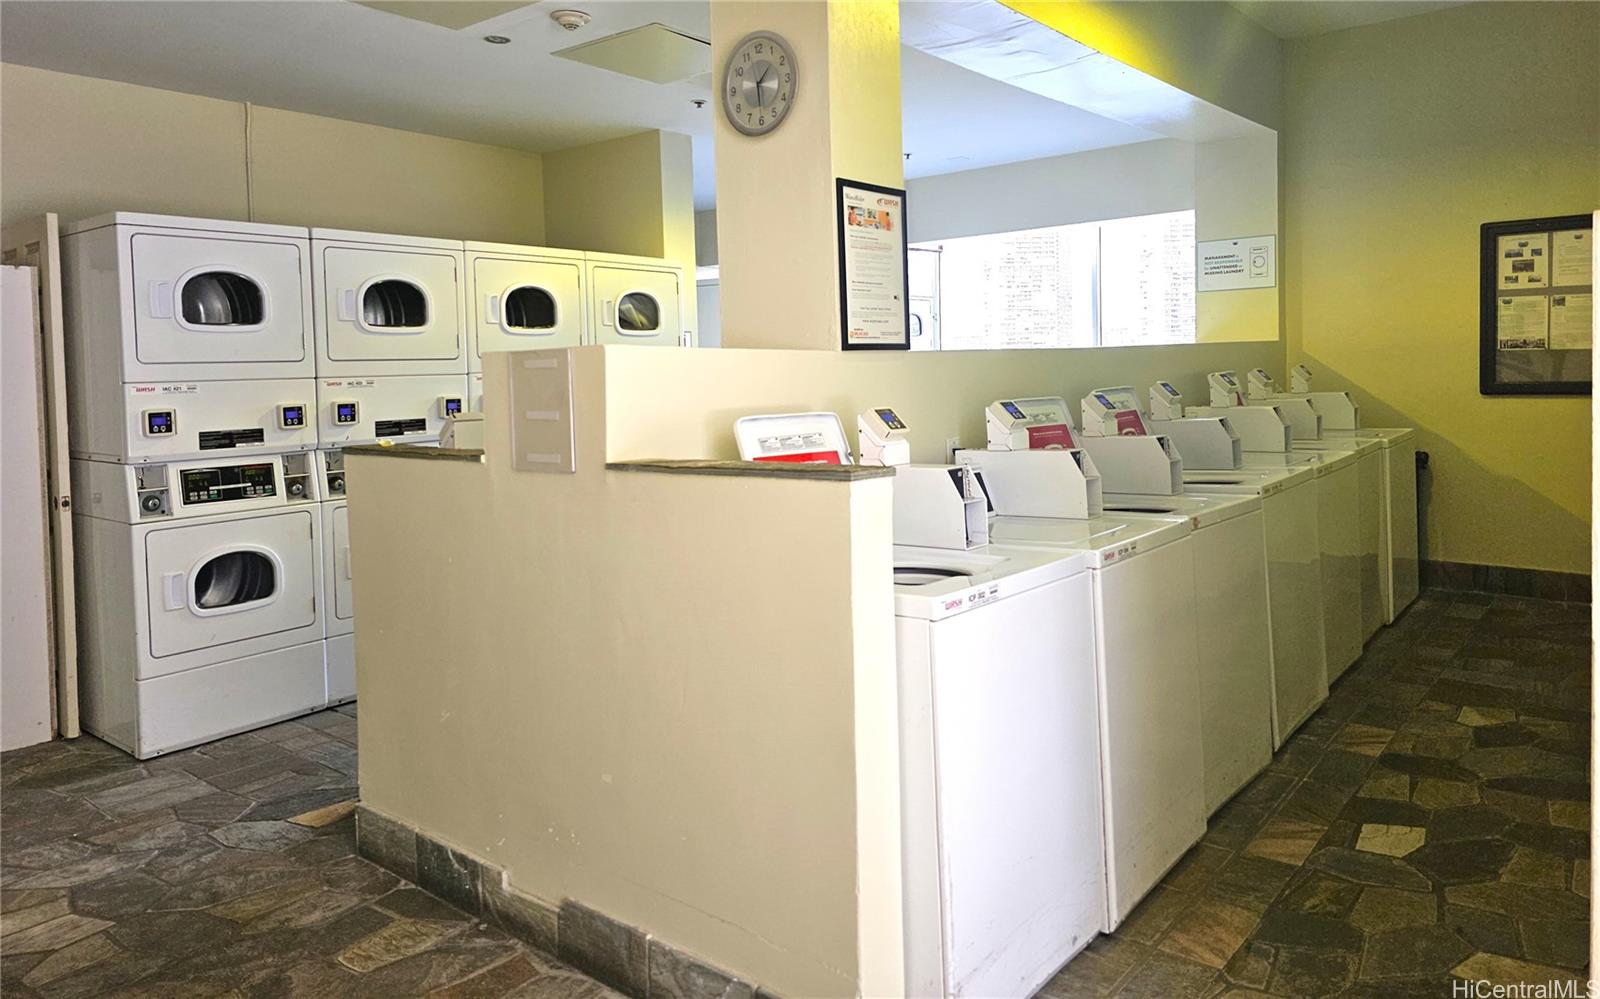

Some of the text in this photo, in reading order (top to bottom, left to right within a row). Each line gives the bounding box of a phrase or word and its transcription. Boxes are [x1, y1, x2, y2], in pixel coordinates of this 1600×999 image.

[754, 43, 764, 54] 12
[769, 46, 774, 55] 1
[742, 53, 751, 62] 11
[779, 55, 785, 66] 2
[735, 66, 744, 77] 10
[784, 73, 791, 83] 3
[730, 86, 736, 96] 9
[780, 93, 786, 102] 4
[735, 103, 741, 113] 8
[771, 107, 777, 118] 5
[747, 113, 752, 123] 7
[759, 116, 765, 126] 6
